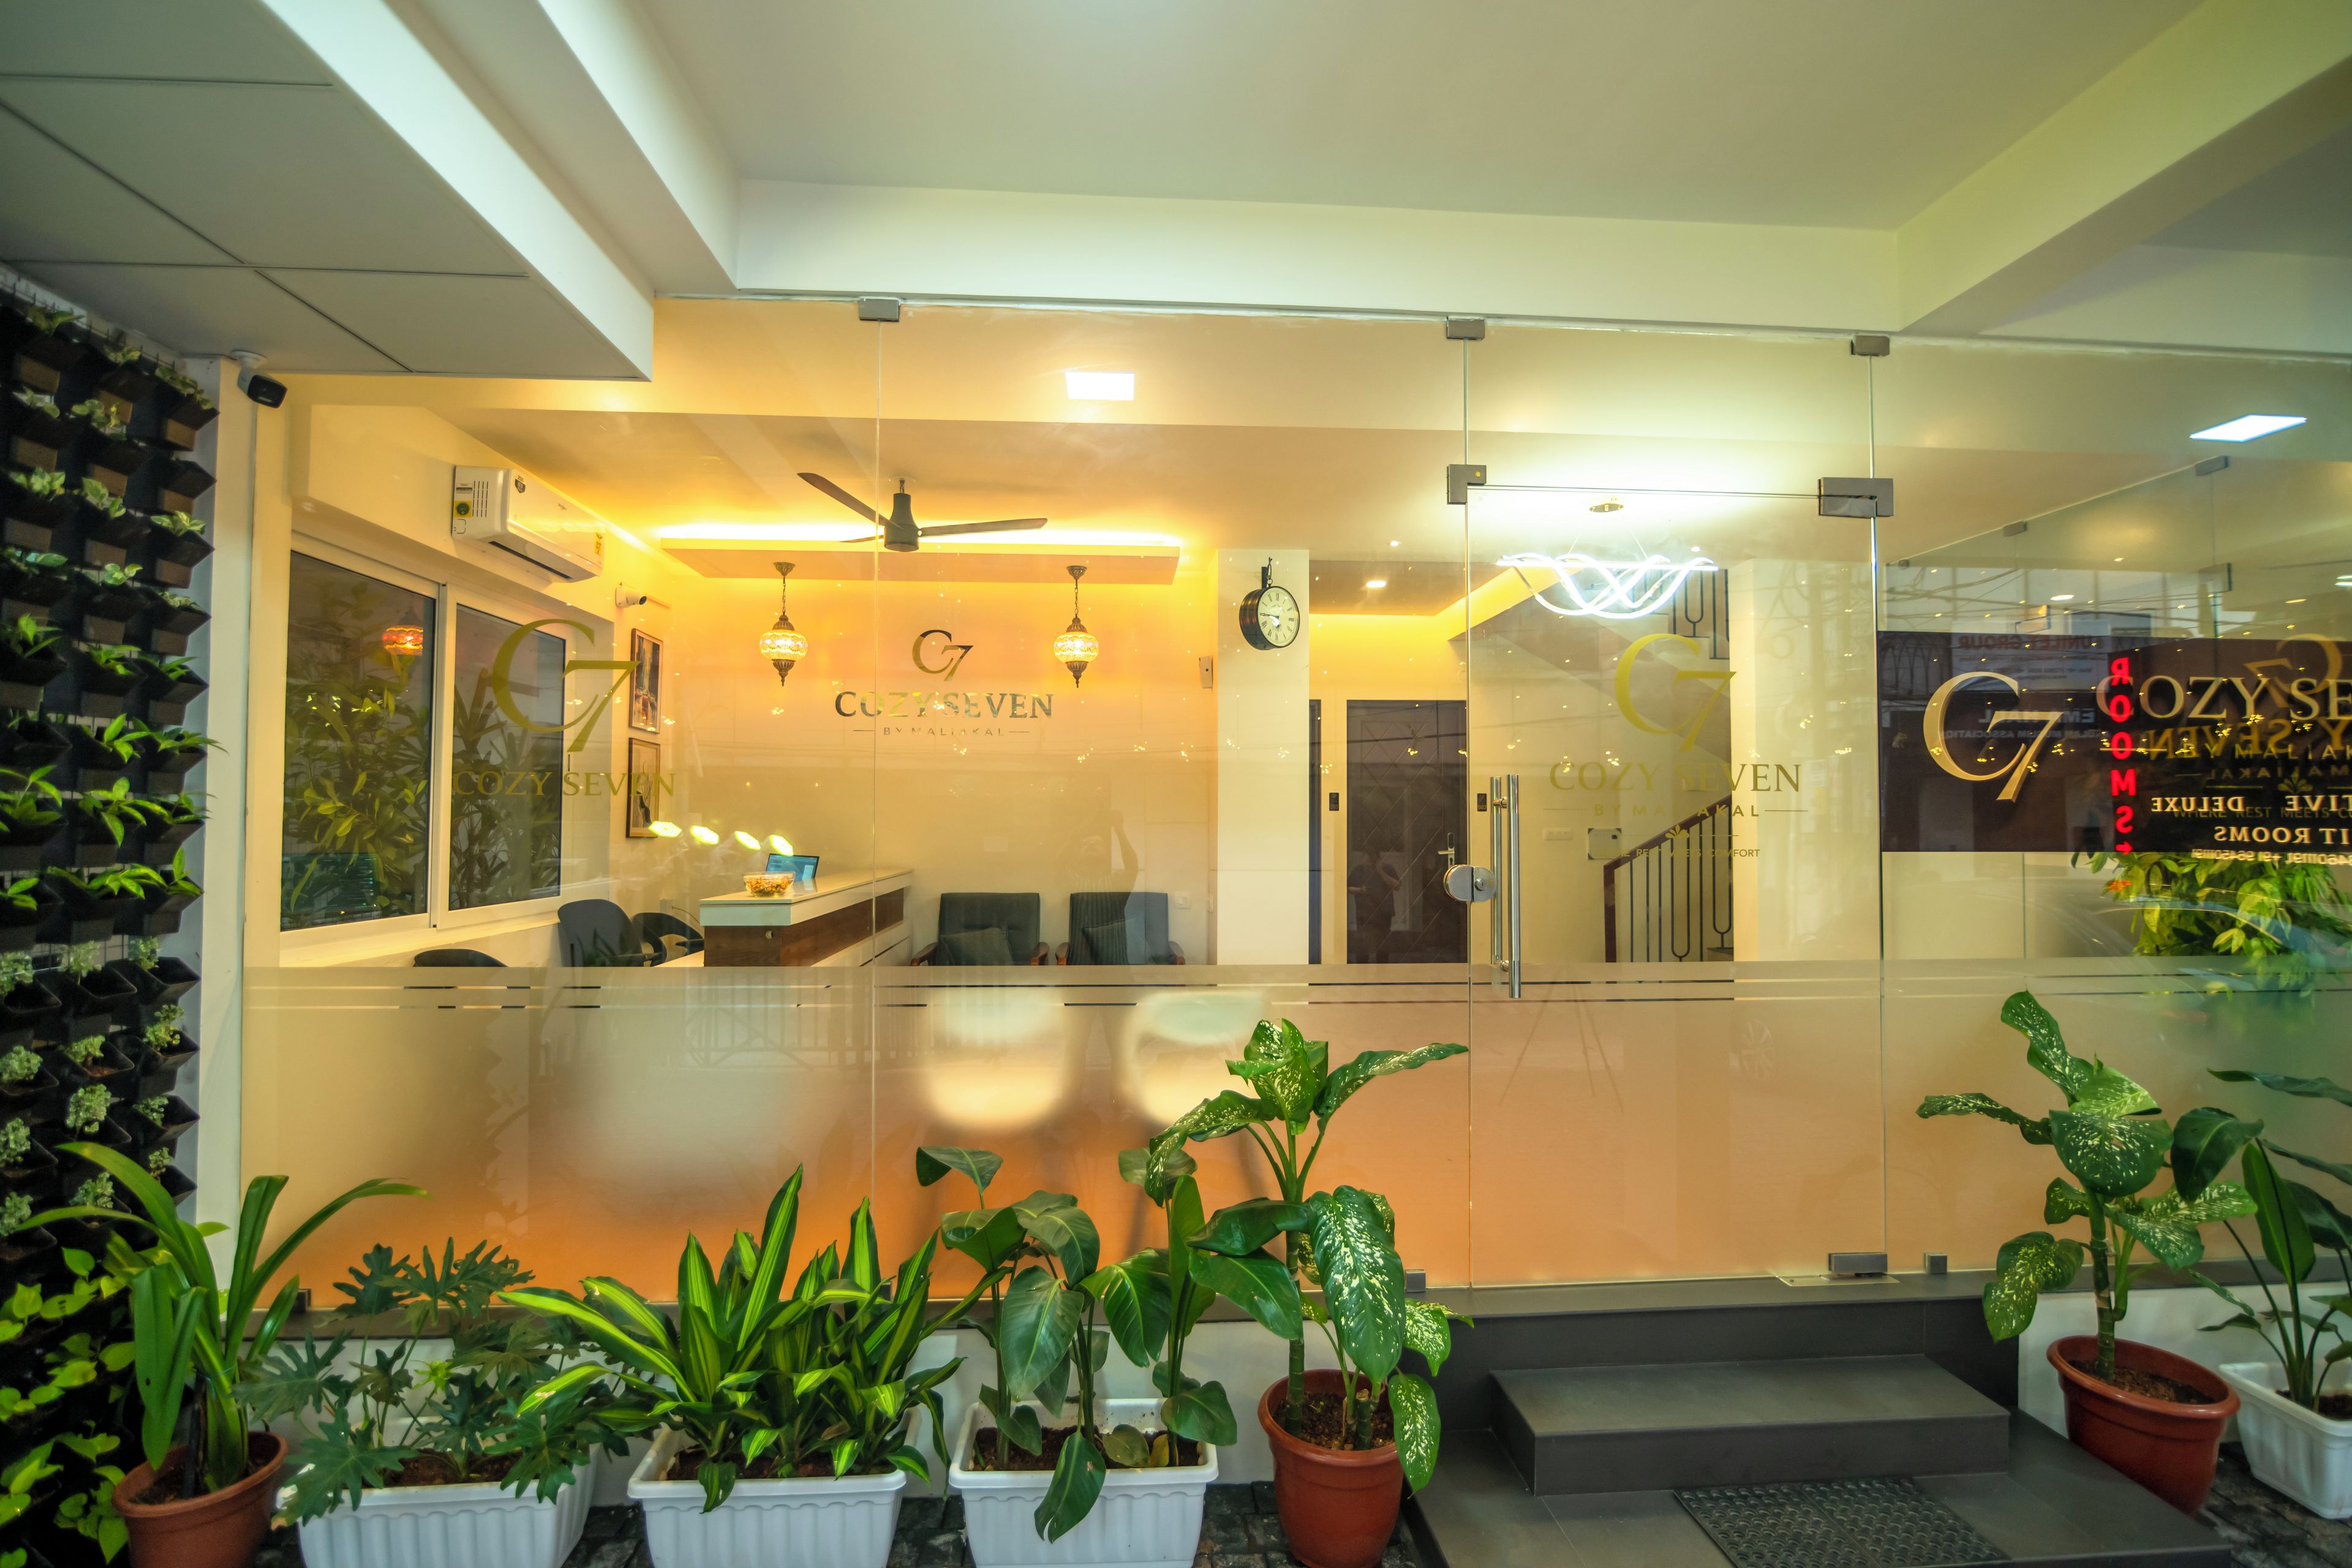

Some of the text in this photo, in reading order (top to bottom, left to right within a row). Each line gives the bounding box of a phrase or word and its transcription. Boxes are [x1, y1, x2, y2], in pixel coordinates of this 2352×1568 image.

[835, 692, 1054, 719] COZY SEVEN
[2096, 675, 2270, 719] COZY
[884, 727, 1005, 736] BY MALIAKAL
[453, 771, 677, 797] COZY SEVEN
[1550, 761, 1801, 793] COZY SEVEN
[1594, 804, 1760, 818] BY MALAKAL
[2236, 807, 2273, 818] REST
[2280, 807, 2330, 818] MEETS
